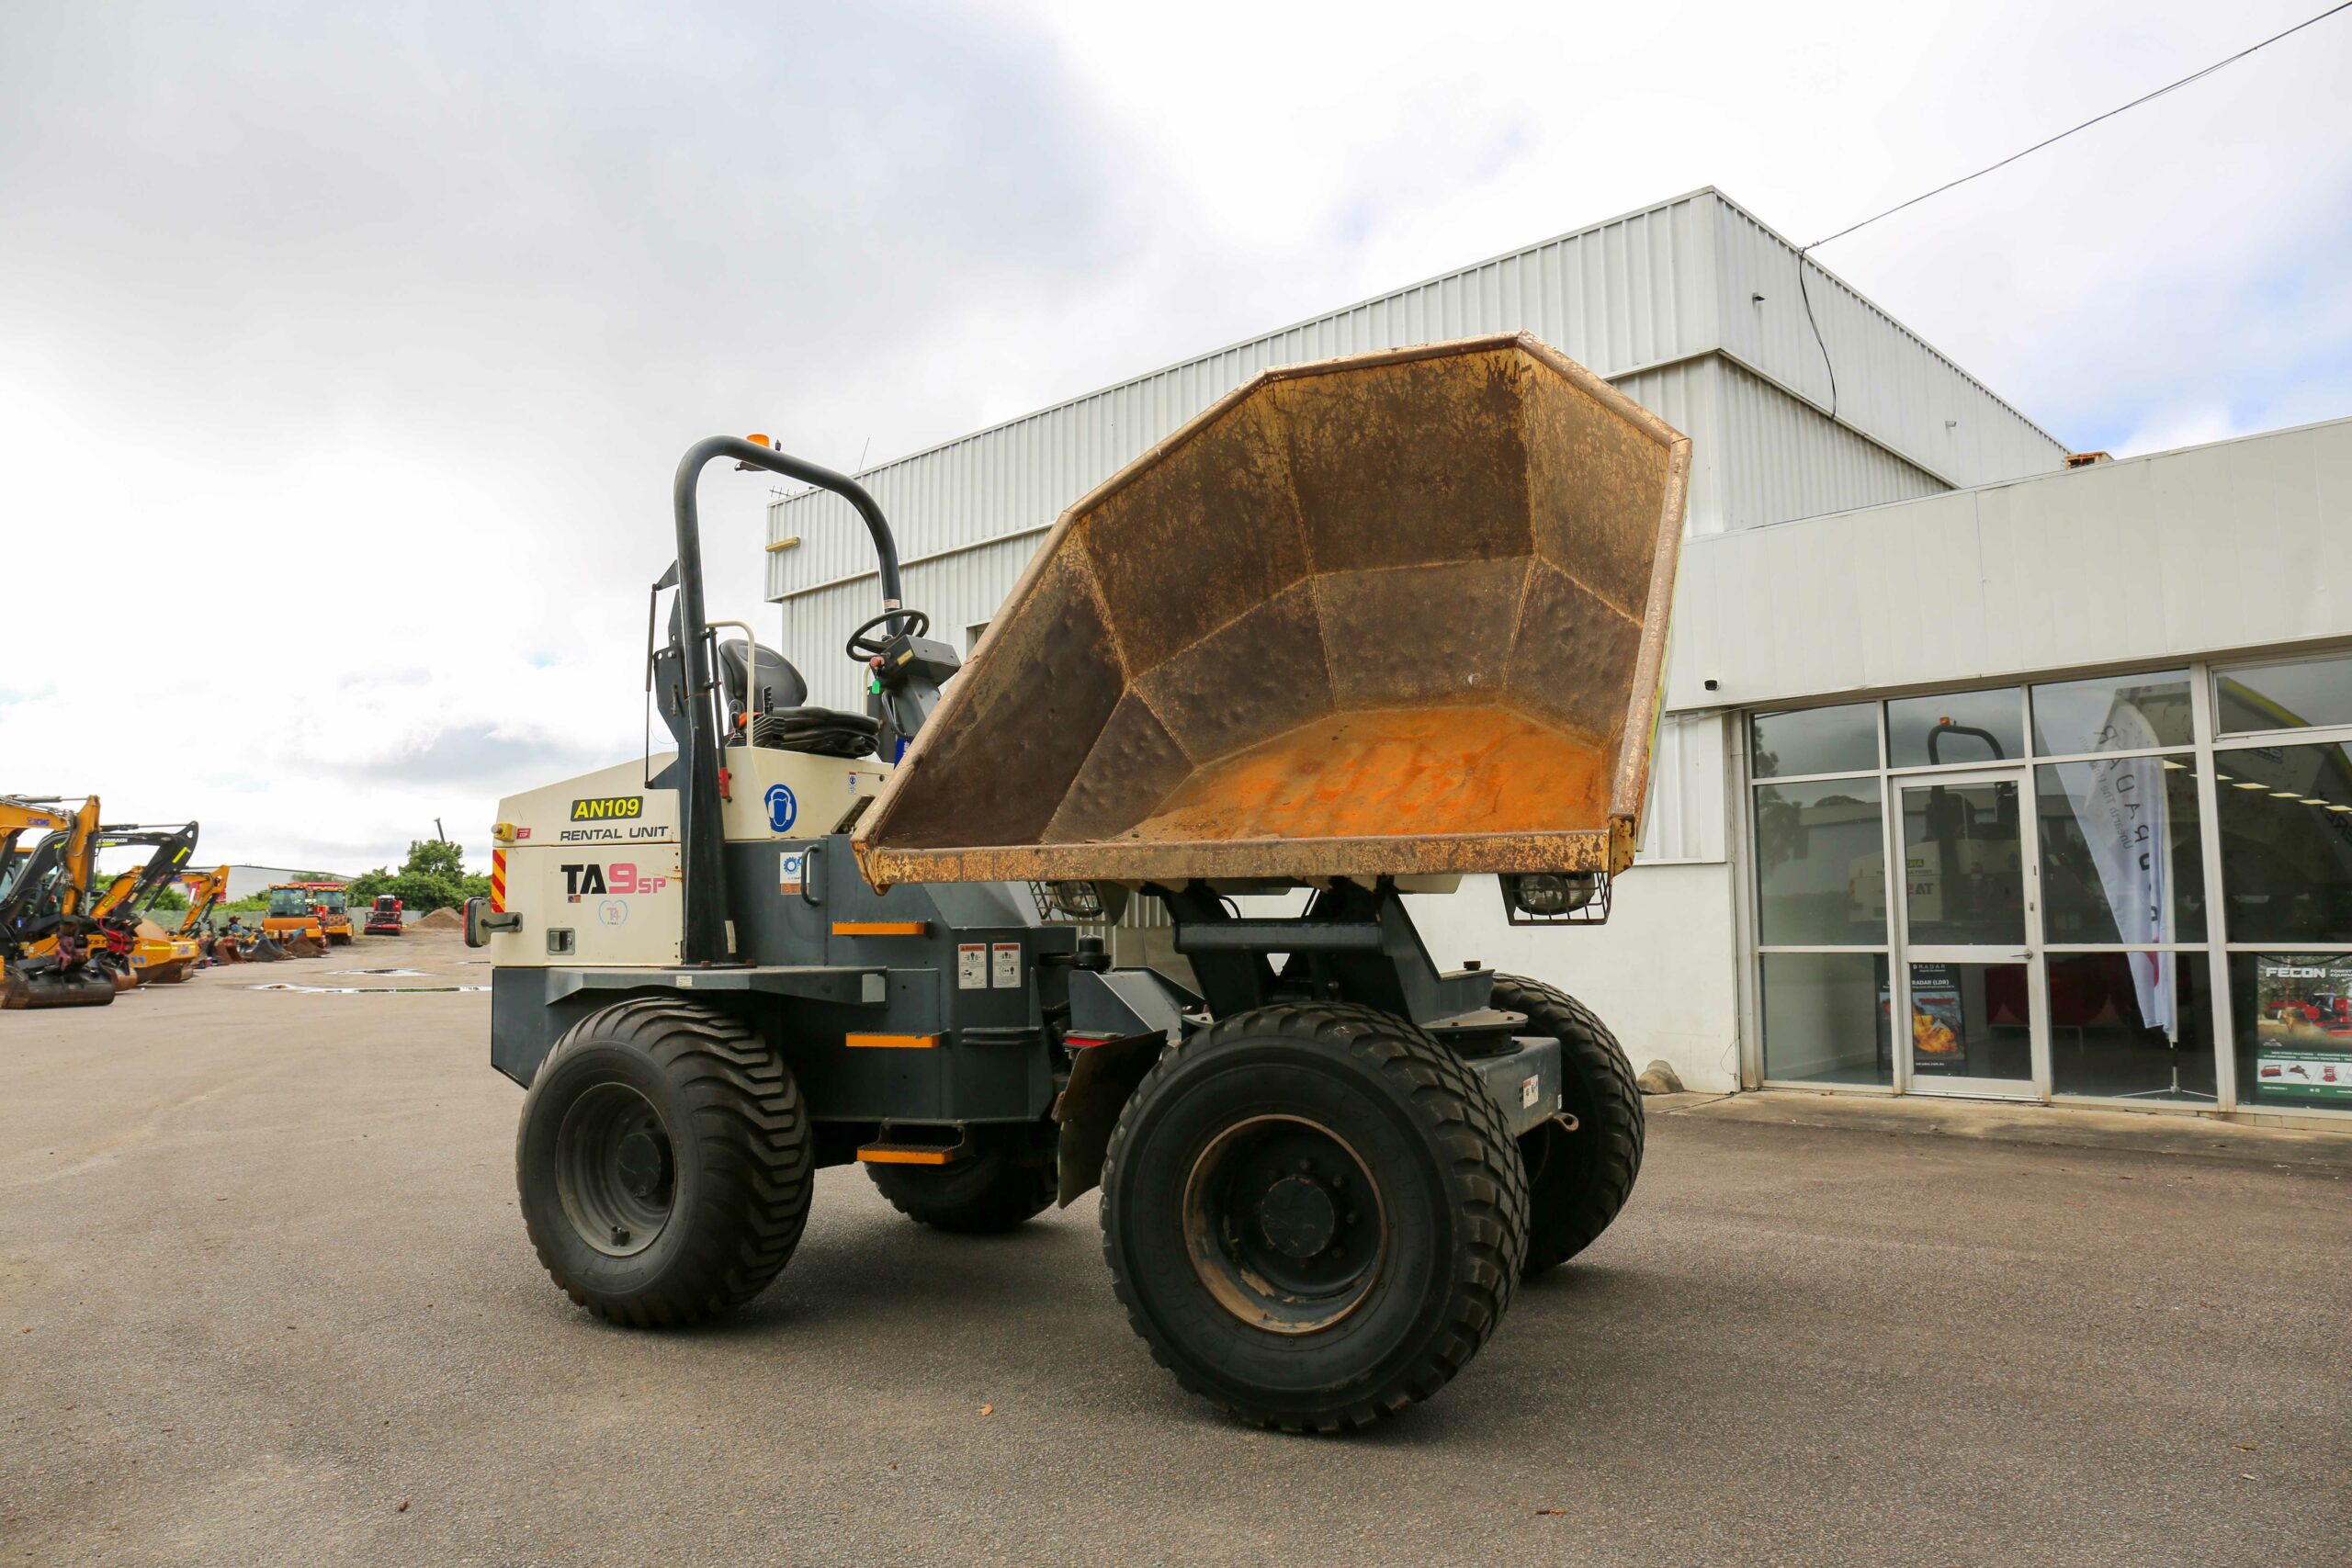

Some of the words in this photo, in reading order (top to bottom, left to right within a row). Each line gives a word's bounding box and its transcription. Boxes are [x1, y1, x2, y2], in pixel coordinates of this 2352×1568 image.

[573, 798, 639, 818] AN109
[560, 829, 623, 841] RENTAL
[628, 826, 669, 838] UNIT
[2266, 967, 2326, 978] FECON
